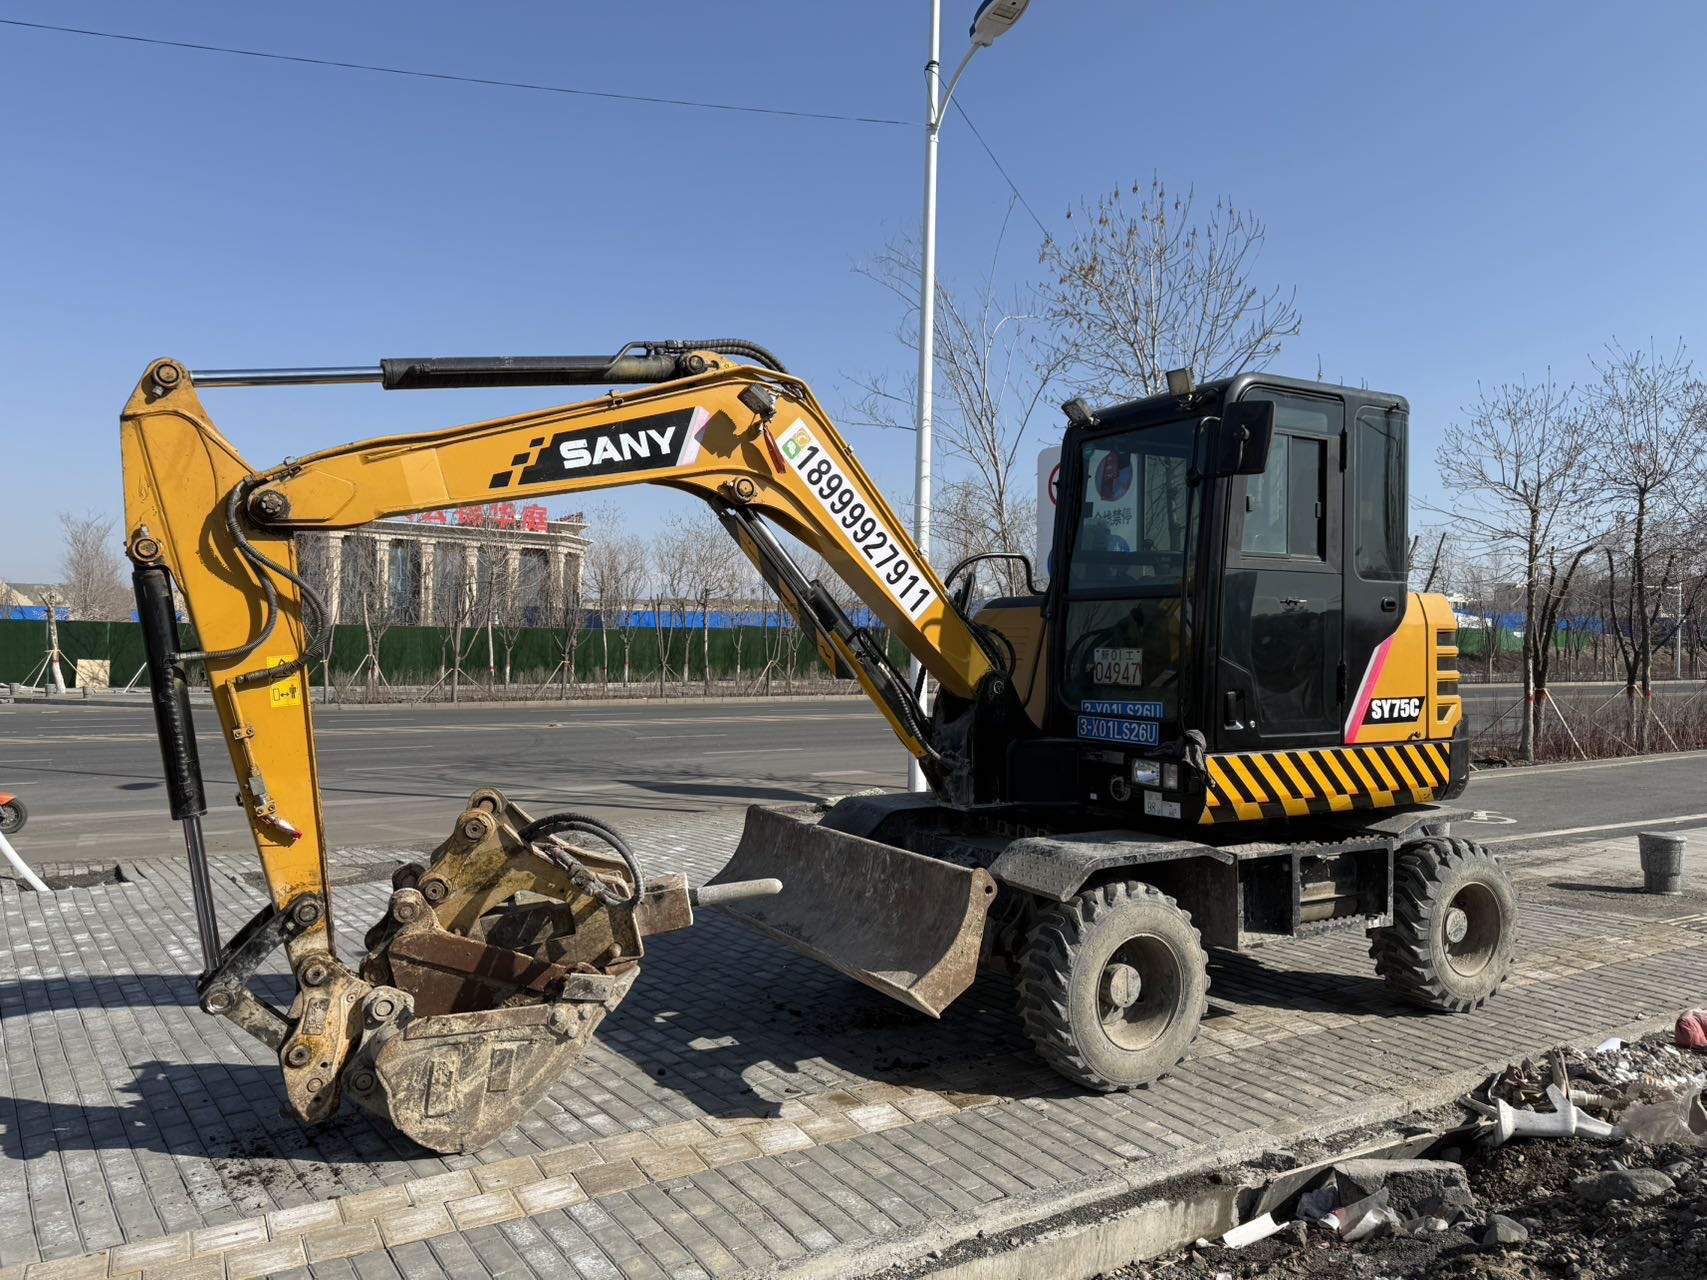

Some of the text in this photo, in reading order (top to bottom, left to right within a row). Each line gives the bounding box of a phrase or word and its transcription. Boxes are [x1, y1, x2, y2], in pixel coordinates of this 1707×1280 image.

[560, 426, 676, 469] SANY
[797, 445, 930, 612] 18999927911
[1096, 662, 1139, 683] 04947
[1371, 698, 1420, 719] SY75C
[1079, 719, 1156, 742] 3-X01LS26U
